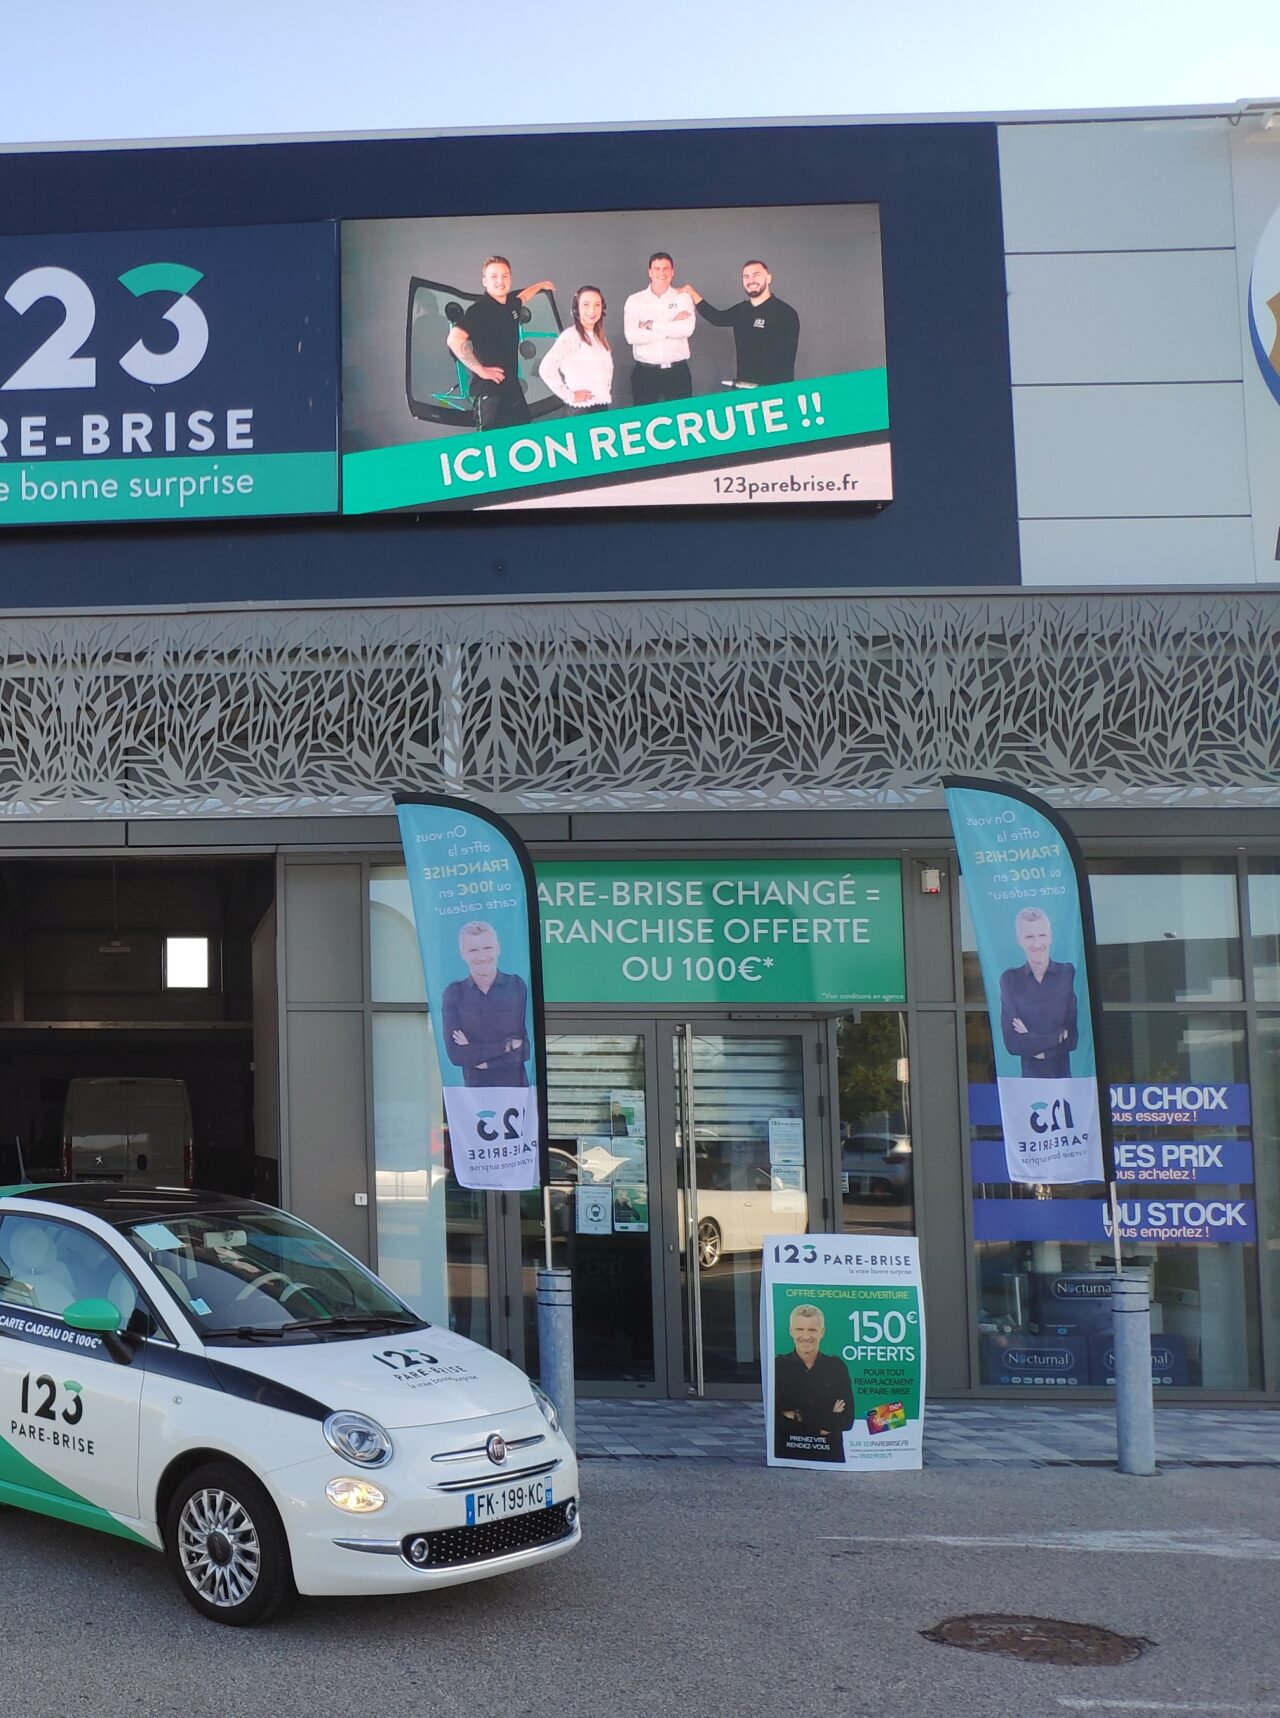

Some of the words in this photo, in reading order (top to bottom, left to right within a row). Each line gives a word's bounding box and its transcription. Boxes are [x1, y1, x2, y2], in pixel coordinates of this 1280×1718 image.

[439, 445, 496, 486] ICI
[508, 432, 578, 474] ON
[589, 396, 789, 462] RECRUTE
[798, 392, 826, 428] !!
[21, 469, 119, 501] bonne
[129, 464, 254, 508] surprise
[713, 474, 859, 500] 123parebrise.fr
[536, 880, 704, 908] ARE-BRISE
[712, 873, 856, 907] CHANGÉ
[866, 888, 881, 902] =
[540, 918, 715, 944] RANCHISE
[723, 918, 870, 944] OFFERTE
[622, 956, 673, 982] OU
[1141, 1086, 1229, 1110] CHOIX
[1111, 1112, 1133, 1122] ous
[1135, 1112, 1190, 1125] essayez
[1193, 1111, 1198, 1122] !
[1162, 1144, 1224, 1168] PRIX
[1116, 1170, 1135, 1180] ous
[1138, 1168, 1190, 1180] achetez
[1192, 1169, 1196, 1180] !
[1147, 1202, 1247, 1227] STOCK
[1140, 1226, 1203, 1240] emportez
[1205, 1226, 1209, 1238] !
[774, 1244, 818, 1264] 123
[824, 1254, 911, 1267] PARE-BRISE
[855, 1267, 870, 1275] vraie
[871, 1267, 889, 1275] bonne
[890, 1268, 912, 1276] surprise
[785, 1288, 816, 1298] OFFRE
[817, 1289, 857, 1299] SPECIALE
[858, 1290, 909, 1300] OUVERTURE
[1057, 1282, 1112, 1295] Nocturna
[0, 1315, 25, 1331] CARTE
[25, 1320, 61, 1340] CADEAU
[60, 1330, 76, 1344] DE
[848, 1310, 918, 1344] 150€
[372, 1348, 439, 1370] 123
[842, 1345, 915, 1362] OFFERTS
[1008, 1353, 1069, 1366] Nocturnal
[855, 1378, 914, 1386] REMPLACEMENT
[863, 1368, 885, 1376] POUR
[886, 1368, 905, 1377] TOUT
[21, 1371, 84, 1425] 123
[857, 1387, 868, 1395] DE
[10, 1420, 95, 1455] PARE-BRISE
[477, 1483, 544, 1517] FK-199-KC
